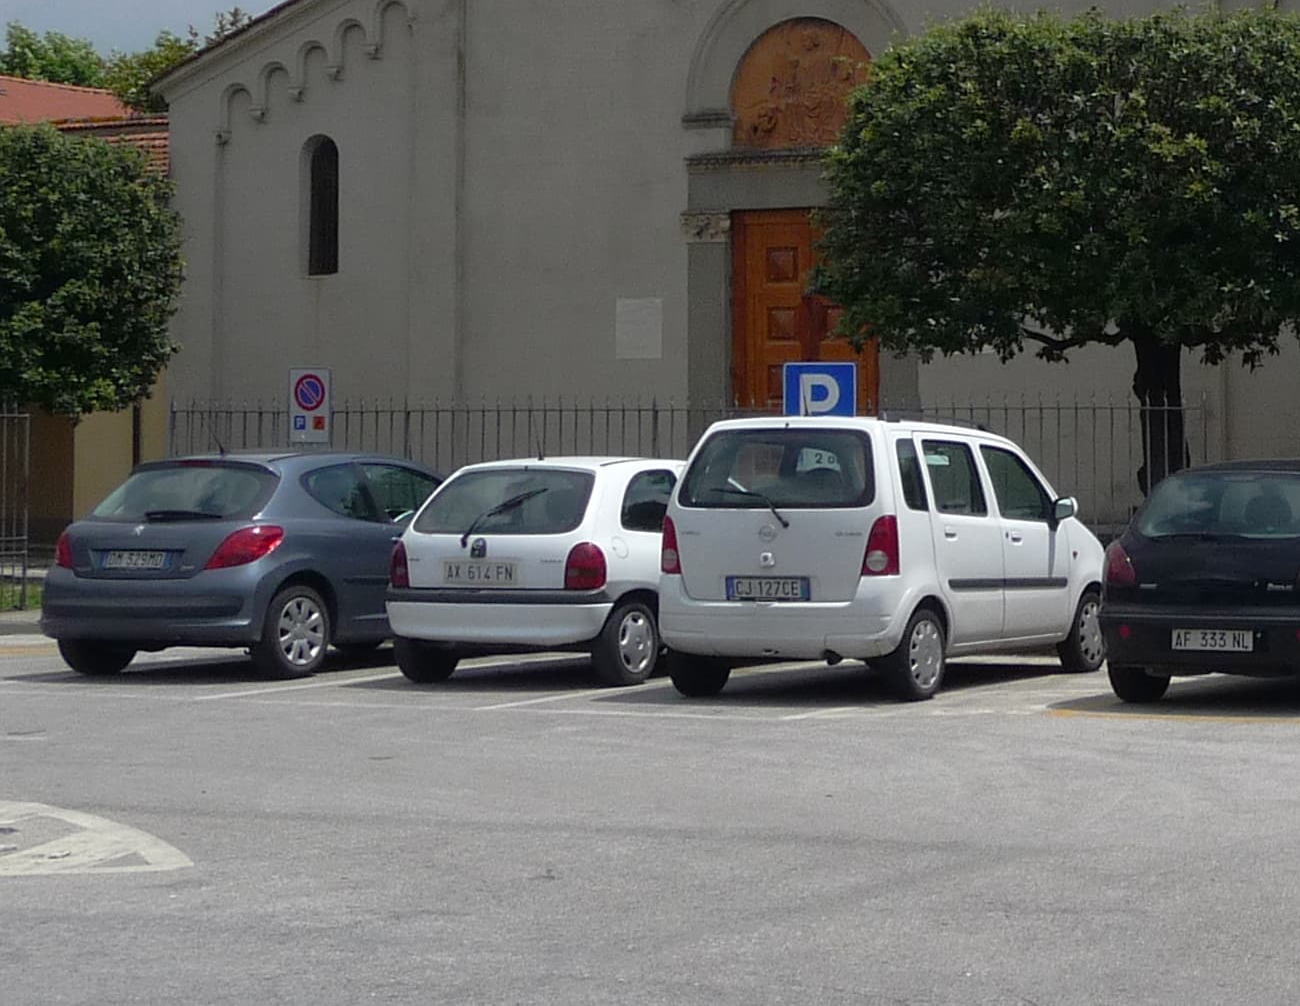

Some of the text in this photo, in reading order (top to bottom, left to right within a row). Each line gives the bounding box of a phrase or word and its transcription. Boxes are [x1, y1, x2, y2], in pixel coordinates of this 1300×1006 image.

[800, 373, 840, 416] P
[447, 565, 513, 581] AX 614 FN
[736, 581, 799, 597] CJ 127CE
[1175, 631, 1249, 649] AF 333 NL
